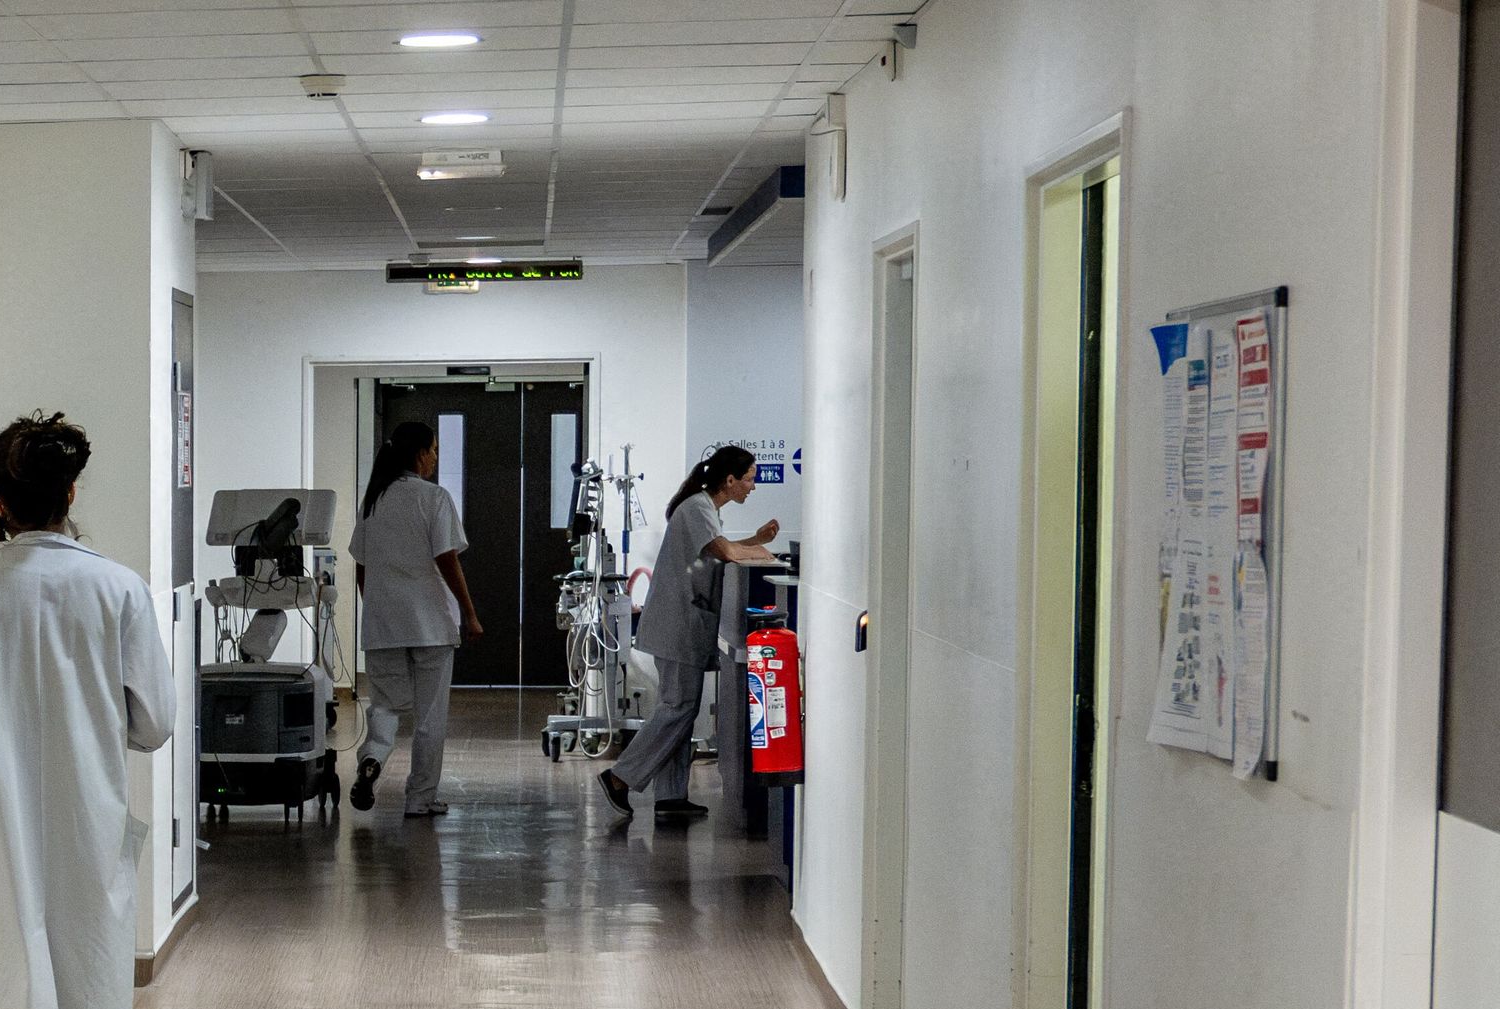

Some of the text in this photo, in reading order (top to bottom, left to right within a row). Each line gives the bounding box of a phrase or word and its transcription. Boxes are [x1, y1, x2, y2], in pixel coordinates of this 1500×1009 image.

[728, 439, 785, 449] Salles 1 à 8
[753, 452, 785, 461] tente
